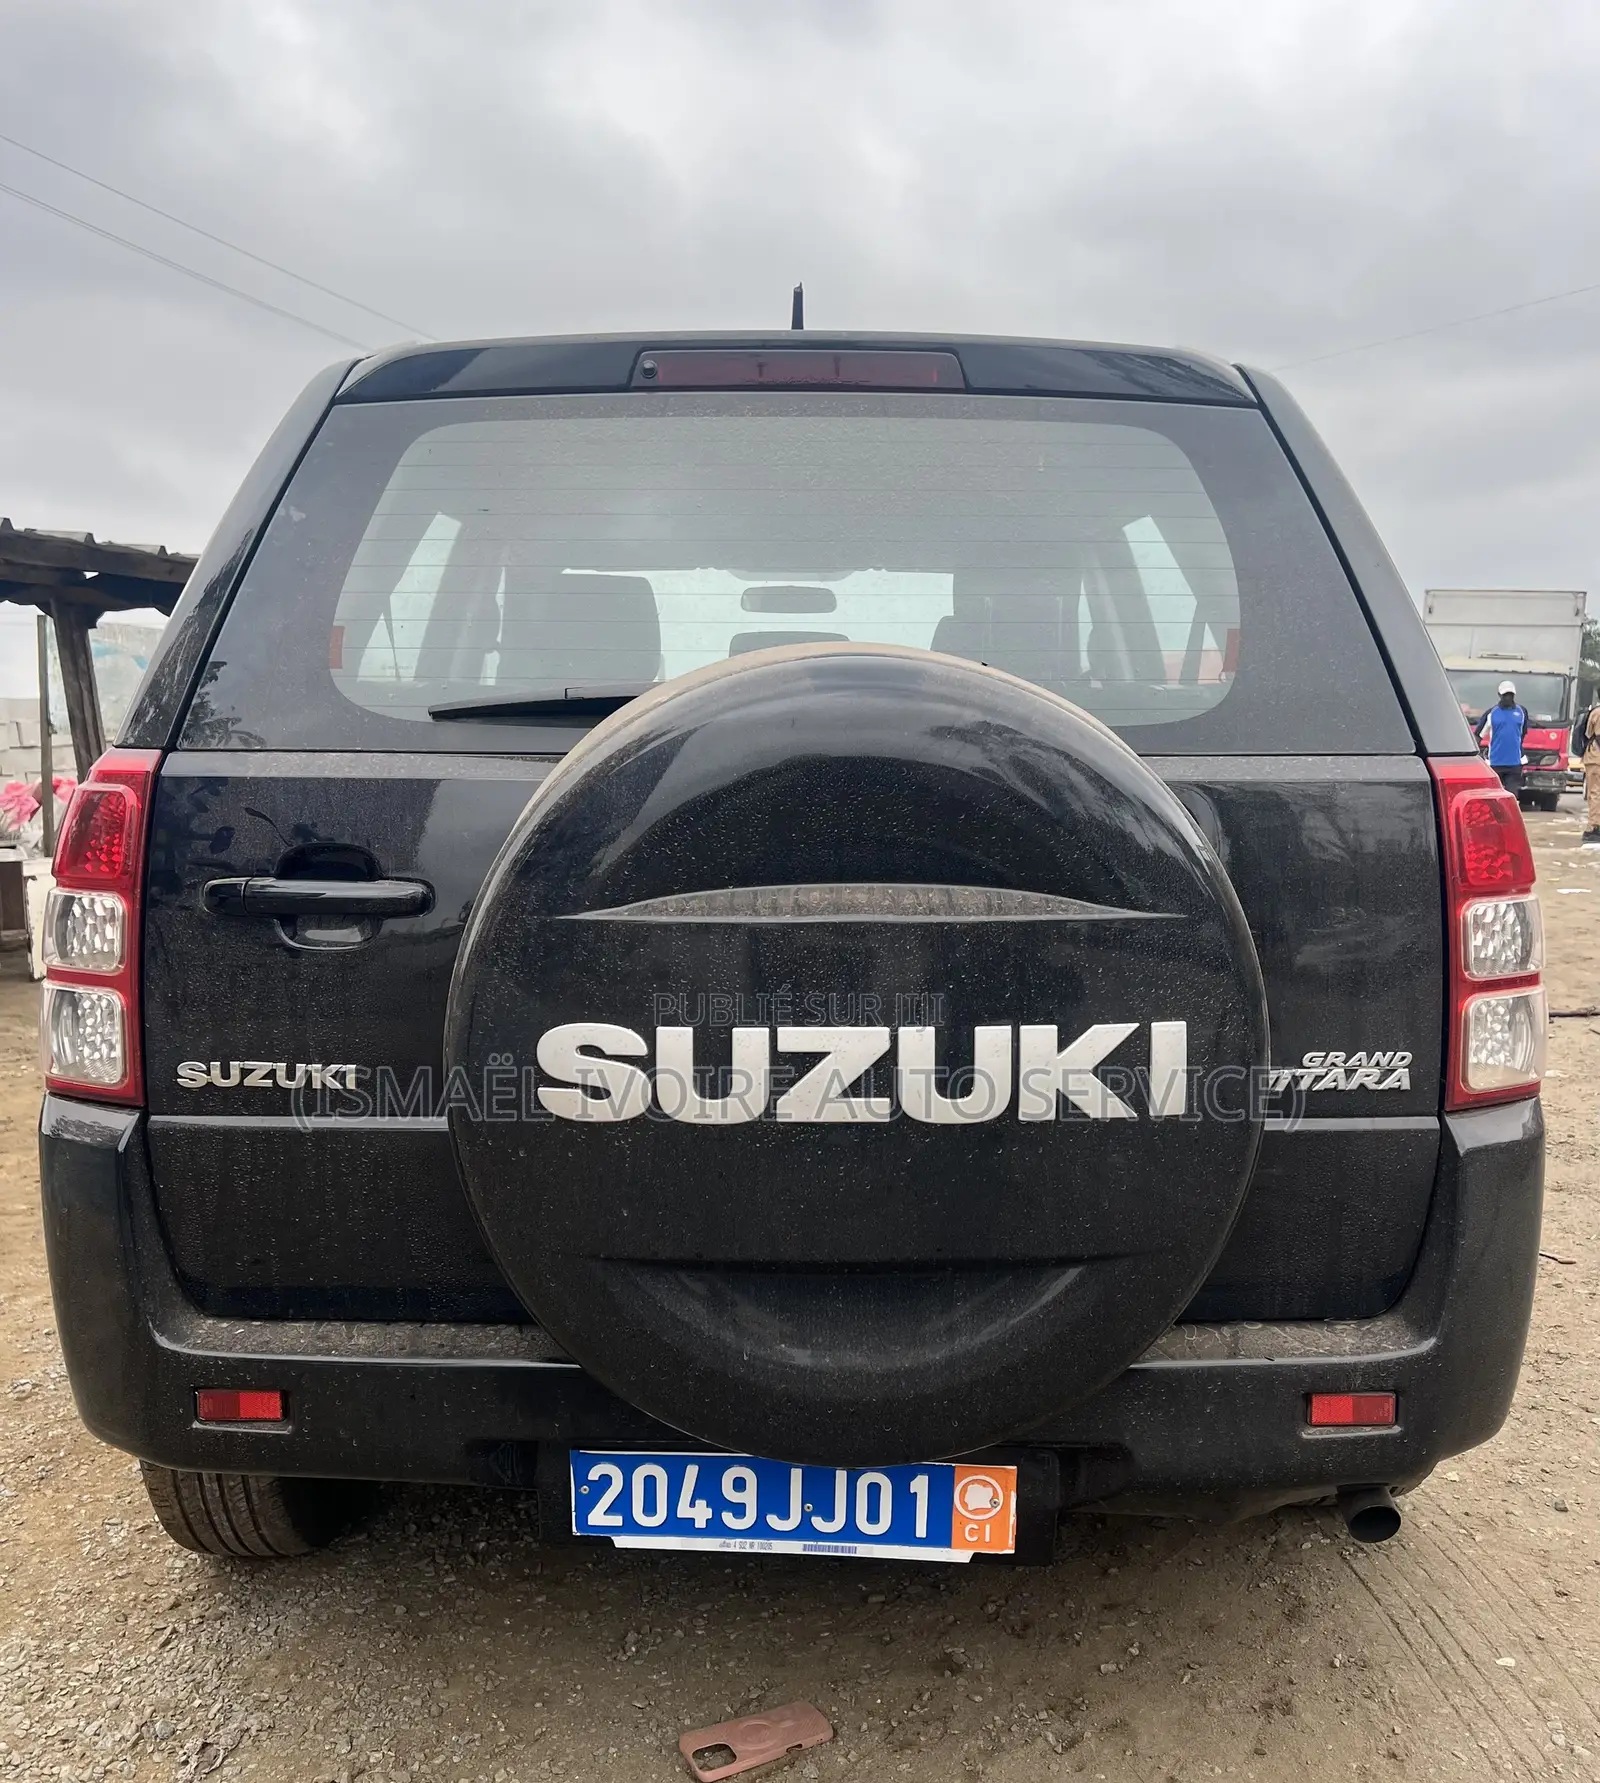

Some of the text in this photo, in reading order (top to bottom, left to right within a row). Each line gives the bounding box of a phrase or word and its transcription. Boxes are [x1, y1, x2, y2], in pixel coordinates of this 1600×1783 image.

[1302, 1051, 1413, 1067] GRAND
[176, 1061, 357, 1090] SUZUKI
[535, 1021, 1188, 1125] SUZUKI
[964, 1523, 991, 1543] CI
